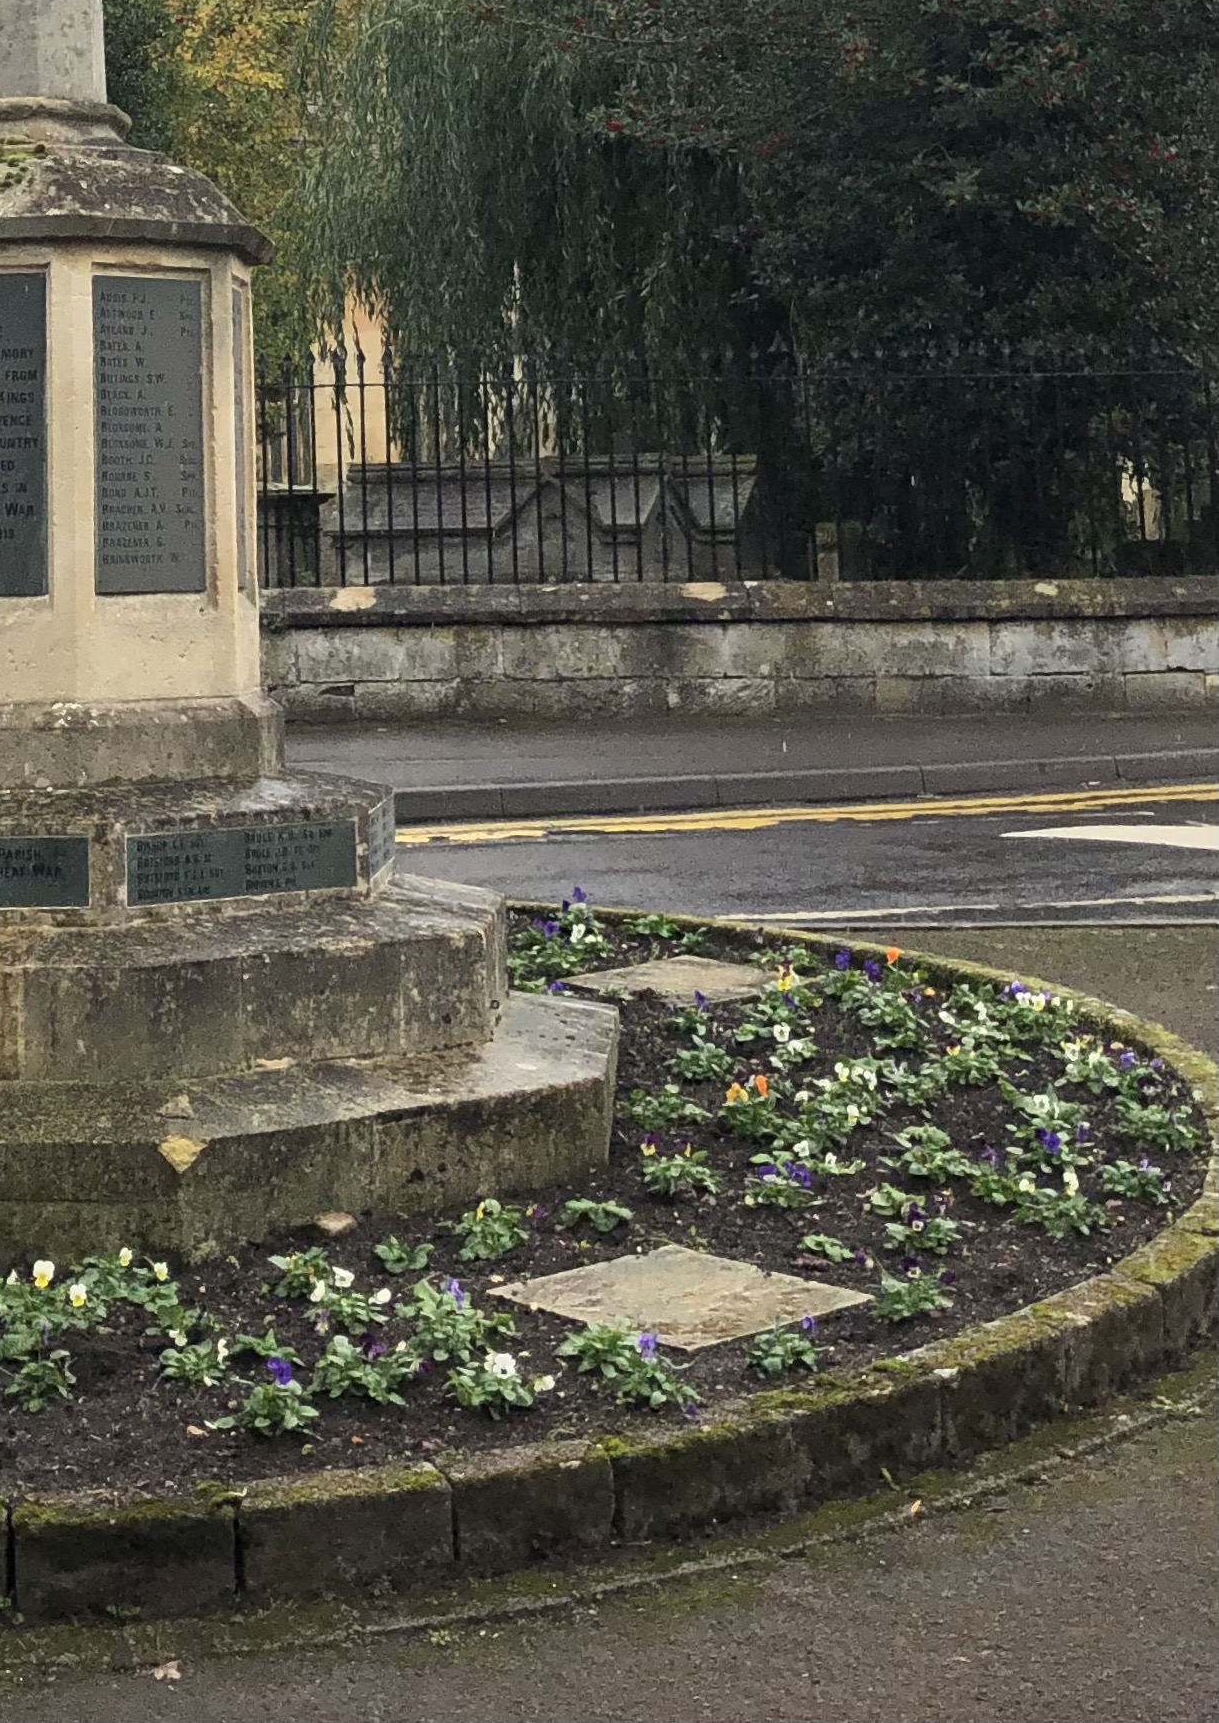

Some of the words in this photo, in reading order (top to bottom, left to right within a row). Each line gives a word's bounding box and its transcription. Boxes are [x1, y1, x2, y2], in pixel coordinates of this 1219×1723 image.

[4, 369, 38, 382] FROM
[14, 482, 28, 494] IN
[4, 502, 35, 517] WAR
[31, 863, 63, 878] WAR
